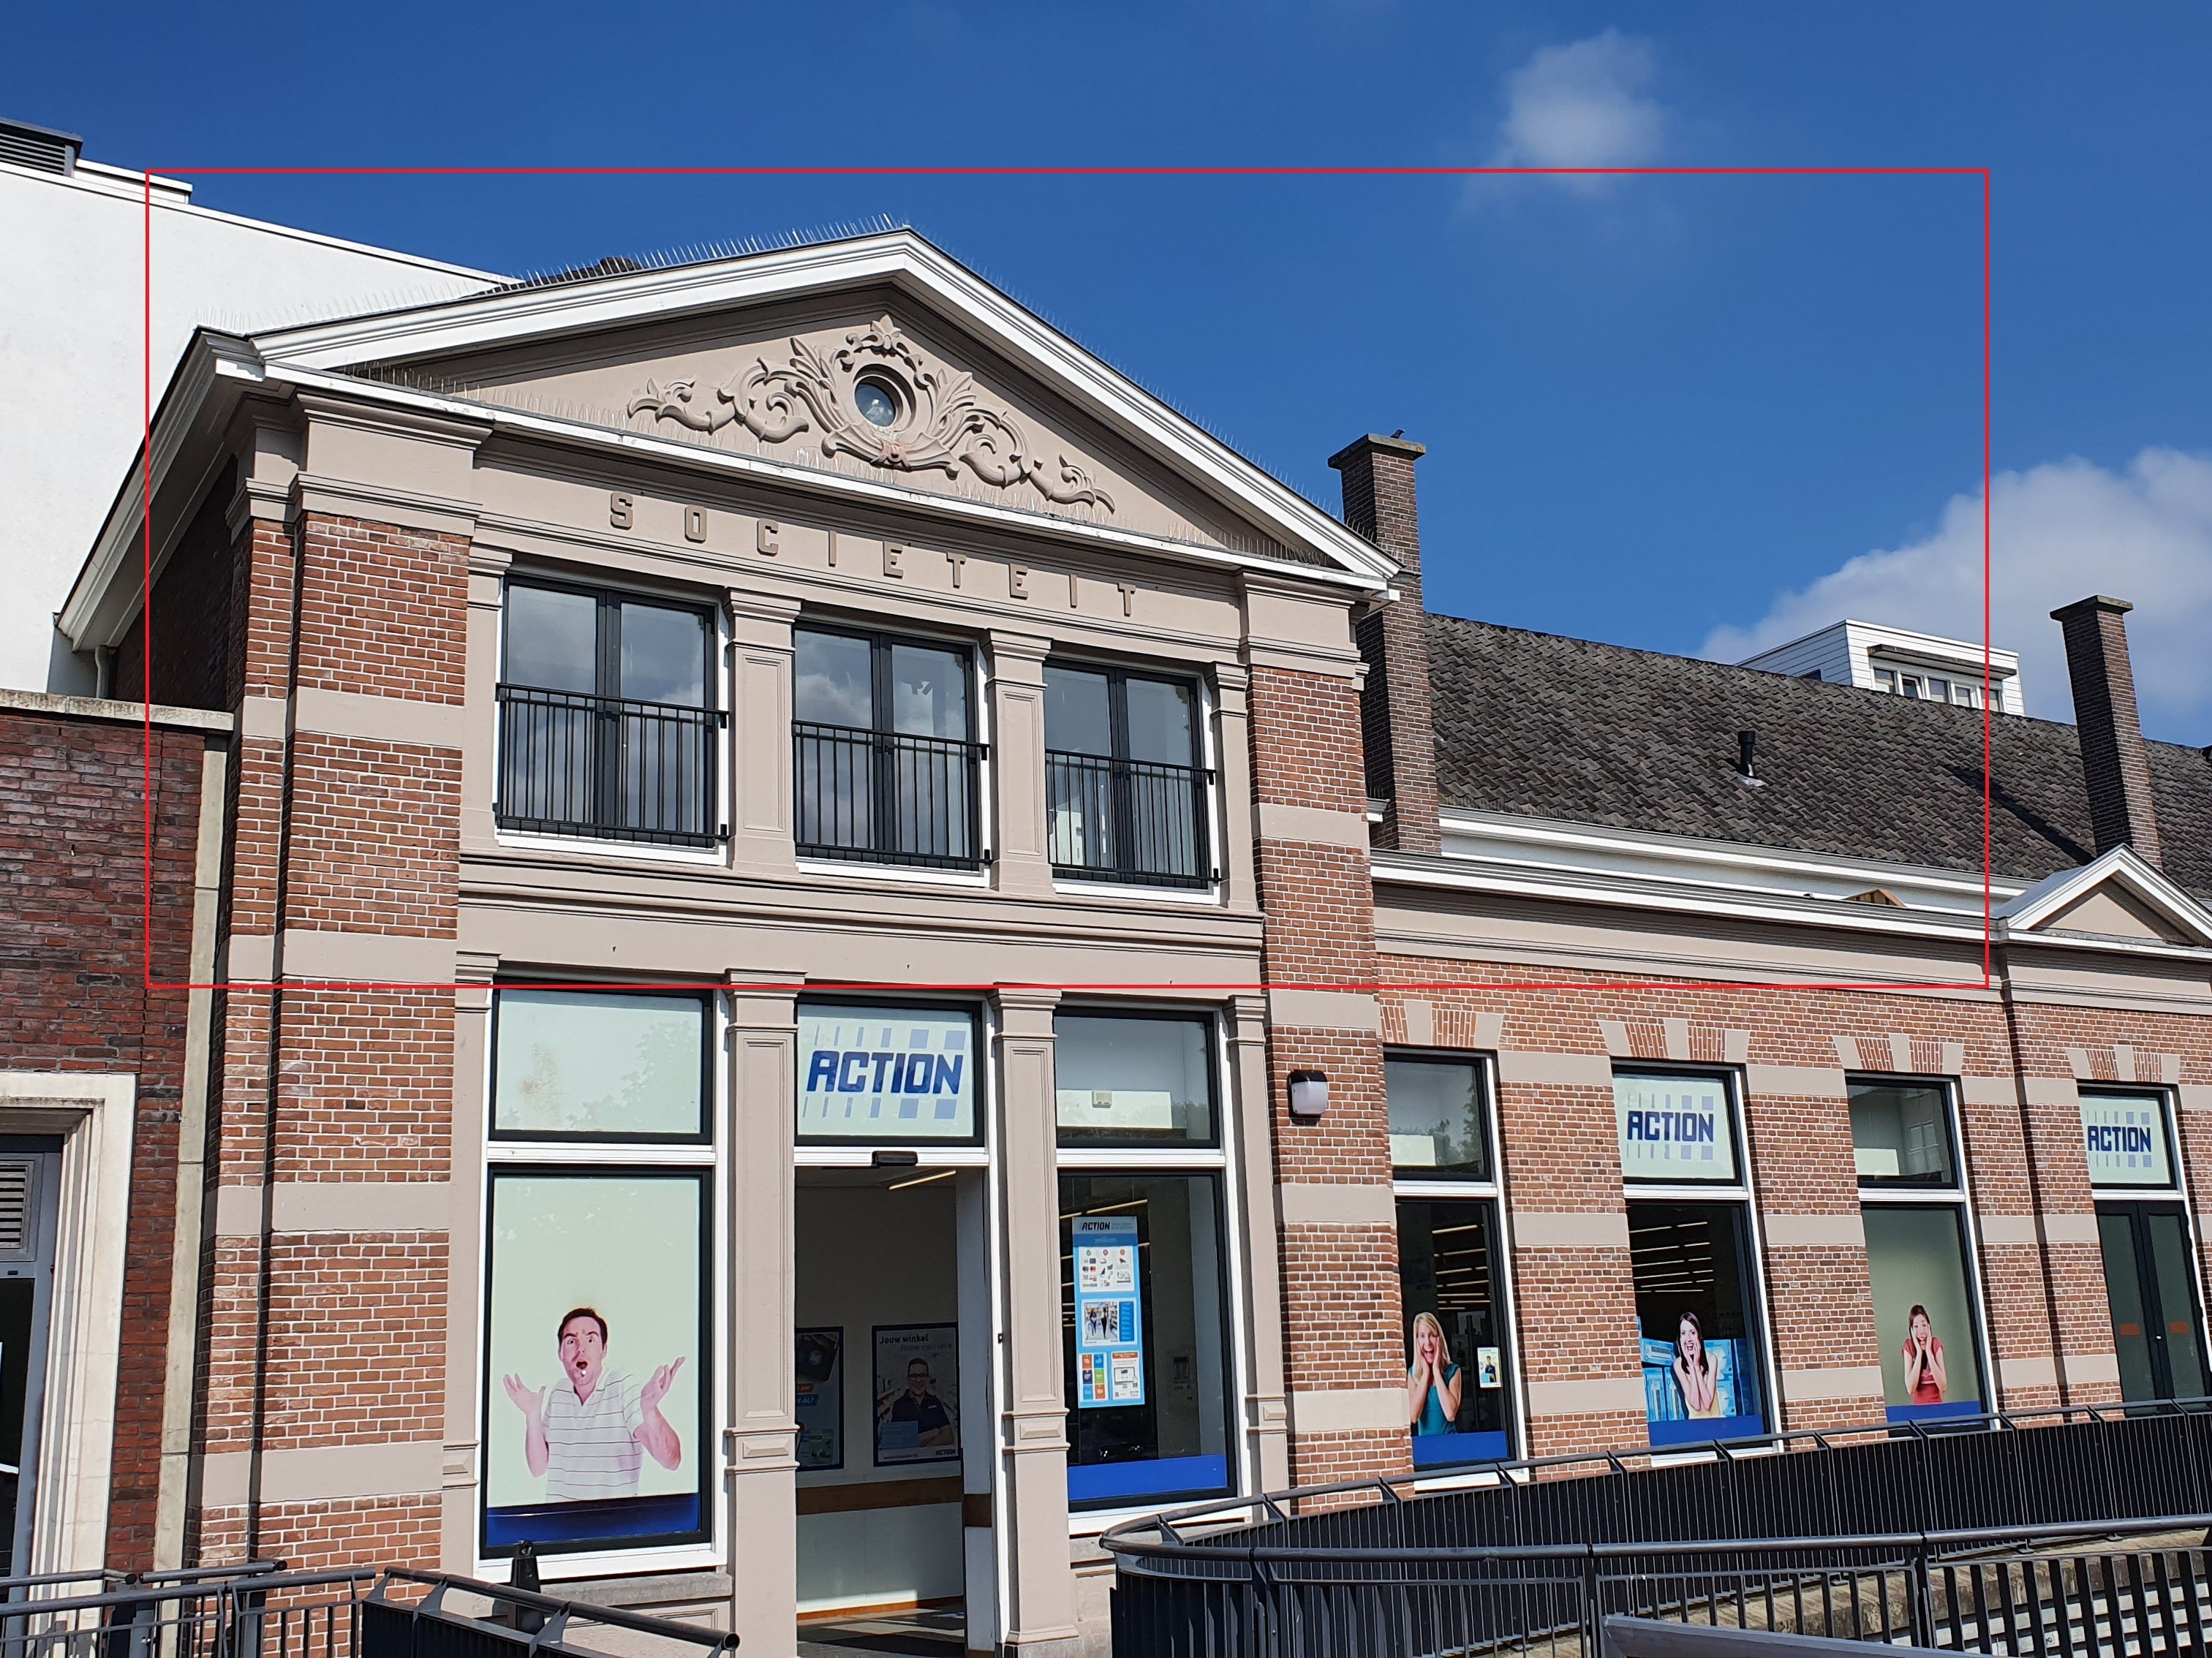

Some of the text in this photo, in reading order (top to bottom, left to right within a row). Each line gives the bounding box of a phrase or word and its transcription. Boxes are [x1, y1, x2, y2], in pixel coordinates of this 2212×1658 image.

[610, 490, 1137, 617] SOCIETEIT
[806, 1050, 964, 1094] ACTION
[1626, 1110, 1715, 1143] ACTION
[2087, 1125, 2152, 1153] ACTION
[1082, 1222, 1111, 1231] ACTION
[880, 1333, 929, 1344] Jouw winkel
